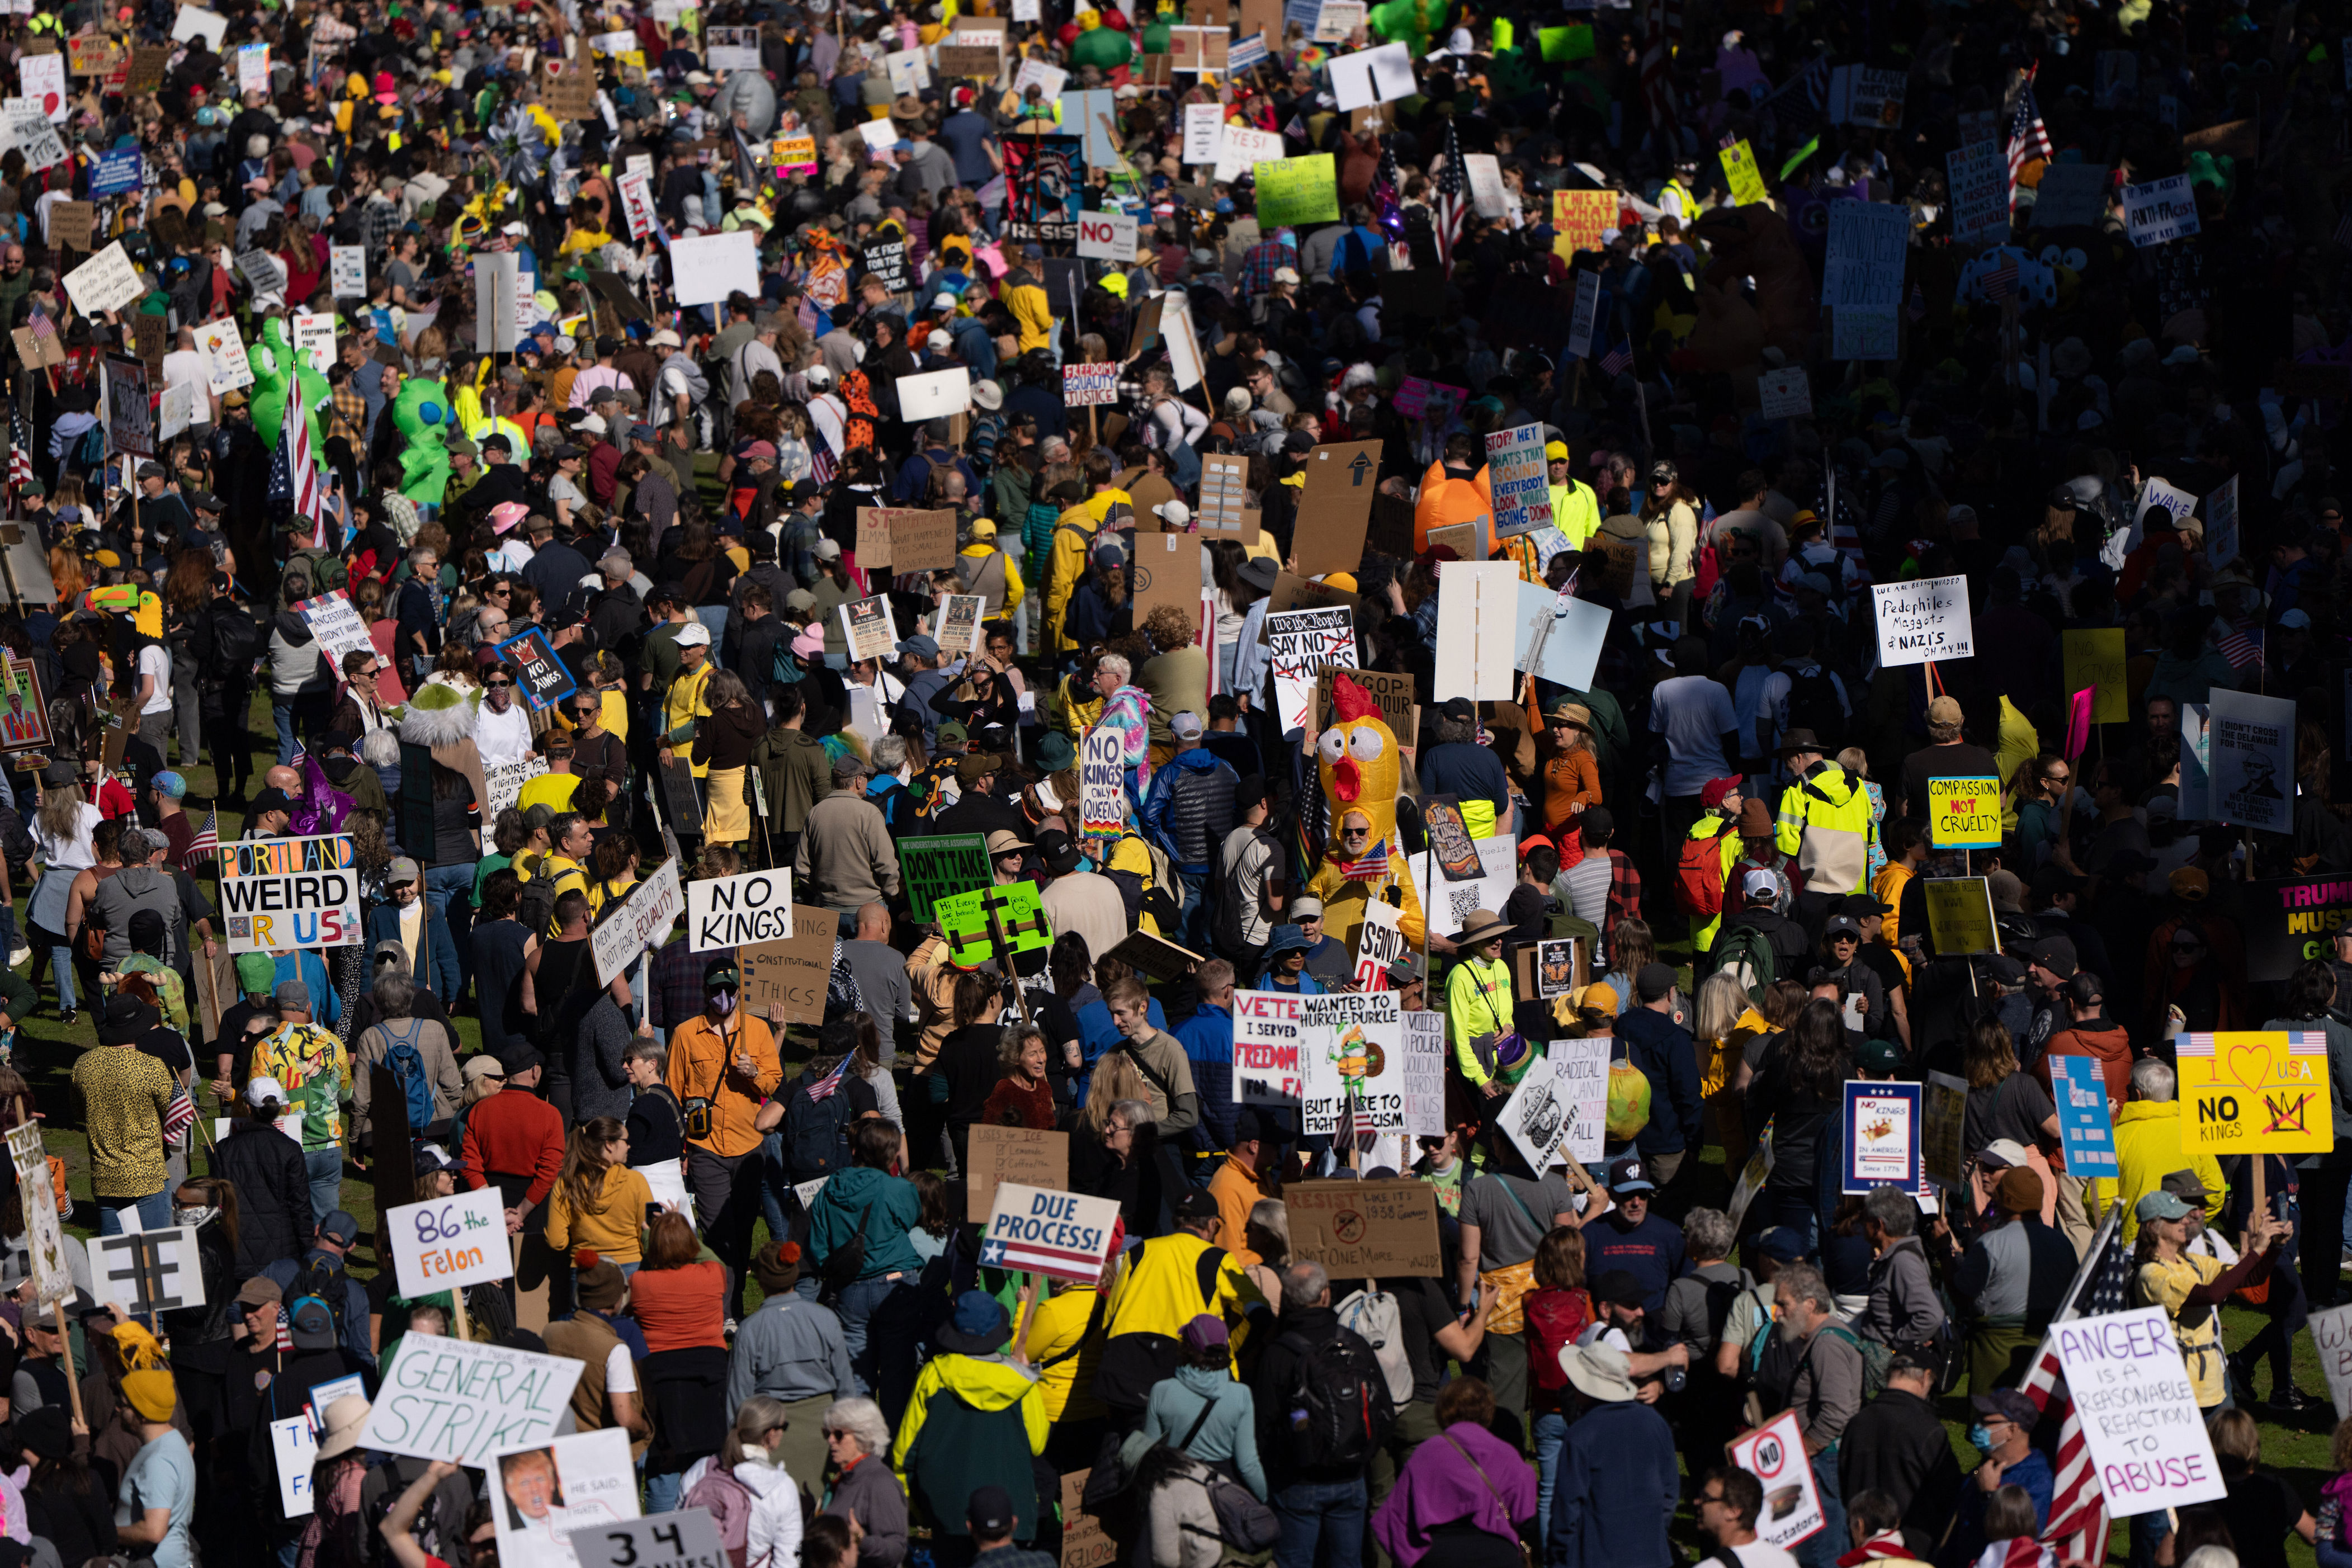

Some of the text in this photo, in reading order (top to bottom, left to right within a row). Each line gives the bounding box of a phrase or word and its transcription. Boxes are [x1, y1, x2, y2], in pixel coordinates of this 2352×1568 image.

[24, 58, 59, 78] ICE
[1231, 130, 1266, 148] YES!
[1557, 192, 1612, 206] THIS IS
[1562, 206, 1612, 219] WHAT
[2132, 202, 2193, 228] ANTI-FACIST
[1081, 222, 1113, 243] NO
[864, 241, 904, 259] WE FIGHT
[866, 253, 903, 270] FOR THE
[1065, 361, 1115, 377] FREEDOM!
[1065, 389, 1116, 405] JUSTICE.
[1485, 426, 1537, 451] STOP! HEY
[1522, 445, 1544, 461] THAT
[1494, 475, 1545, 497] EVERYBODY
[1494, 494, 1517, 513] LOOK
[2148, 484, 2190, 517] WAKE
[1497, 502, 1553, 527] GOING DOWN
[914, 529, 951, 542] HAPPENED
[912, 542, 940, 552] SMALL
[1877, 584, 1908, 595] WE ARE
[1882, 596, 1953, 617] Pedophiles
[314, 608, 355, 627] ANCESTORS
[855, 615, 878, 625] 10.18.2025
[1892, 614, 1945, 632] Maggots
[319, 622, 361, 643] DIDN'T WANT
[1898, 631, 1945, 650] NAZI'S
[333, 638, 357, 655] KING
[1270, 631, 1325, 657] SAY NO
[1924, 644, 1954, 657] OH MY
[2074, 641, 2094, 657] NO
[527, 658, 550, 679] NO!
[2077, 663, 2125, 683] KINGS
[531, 669, 562, 693] KINGS
[1364, 673, 1409, 691] GOP:
[2220, 728, 2278, 747] THE DELAWARE
[2225, 721, 2279, 738] DIDN'T CROSS
[1088, 735, 1120, 763] NO
[2220, 739, 2235, 748] FOR
[485, 762, 526, 782] THE MORE
[1084, 764, 1123, 788] KINGS
[492, 775, 526, 789] TIGHTEN
[1930, 780, 1997, 796] COMPASSION
[490, 788, 512, 802] GRIP
[1091, 788, 1110, 799] ONLY
[2229, 791, 2270, 807] NO KINGS.
[1084, 799, 1122, 820] QUEENS
[1950, 798, 1976, 814] NOT
[2238, 802, 2275, 817] CLOWNS.
[1433, 807, 1448, 825] NO
[1940, 814, 1999, 833] CRUELTY
[2245, 813, 2271, 825] CULTS.
[1430, 822, 1464, 838] KINGS
[910, 838, 981, 849] UNDERSTAND ASSIGNMENT
[1438, 841, 1475, 864] AMERICA
[1480, 846, 1507, 857] Fuels
[223, 836, 355, 879] PORTLAND
[905, 848, 988, 881] DON'T TAKE
[224, 874, 348, 913] WEIRD
[711, 876, 772, 912] NO
[939, 901, 951, 911] Hi
[956, 908, 975, 917] behind
[594, 883, 656, 951] MEN QUALITY
[253, 909, 343, 947] R US
[602, 888, 674, 971] NOT EQUALITY
[700, 906, 786, 948] KINGS
[1303, 995, 1390, 1013] WANTED TO
[1300, 1008, 1398, 1028] HURKLE-DURKLE
[1409, 1013, 1442, 1033] VOICES
[1258, 1023, 1297, 1038] SERVED
[1410, 1035, 1443, 1054] POWER
[1556, 1060, 1600, 1079] RADICAL
[2207, 1059, 2313, 1082] I USA
[1246, 1079, 1268, 1096] FOR
[1305, 1094, 1401, 1115] BUT TO
[1521, 1088, 1545, 1122] RESIST
[1860, 1100, 1906, 1116] NO KINGS
[2197, 1096, 2240, 1123] NO
[977, 1129, 1043, 1141] USES ICE
[1571, 1122, 1594, 1140] ALL
[2200, 1122, 2243, 1142] KINGS
[1534, 1132, 1564, 1173] HANDS
[1870, 1145, 1906, 1154] AMERICA!
[1863, 1165, 1901, 1173] Since 1776
[1031, 1193, 1078, 1221] DUE
[1289, 1192, 1389, 1210] RESIST LIKE
[1365, 1206, 1395, 1220] 1938
[414, 1203, 489, 1244] 86 the
[993, 1213, 1103, 1252] PROCESS!
[419, 1246, 483, 1278] Felon
[1297, 1247, 1356, 1267] NOT ONE
[2061, 1317, 2177, 1366] ANGER
[397, 1350, 552, 1414] GENERAL
[2095, 1364, 2141, 1385] IS A
[2077, 1380, 2193, 1415] REASONABLE
[373, 1394, 552, 1461] STRIKE
[2099, 1405, 2193, 1439] REACTION
[2123, 1434, 2160, 1457] TO
[1758, 1442, 1780, 1469] NO
[2104, 1453, 2207, 1499] ABUSE
